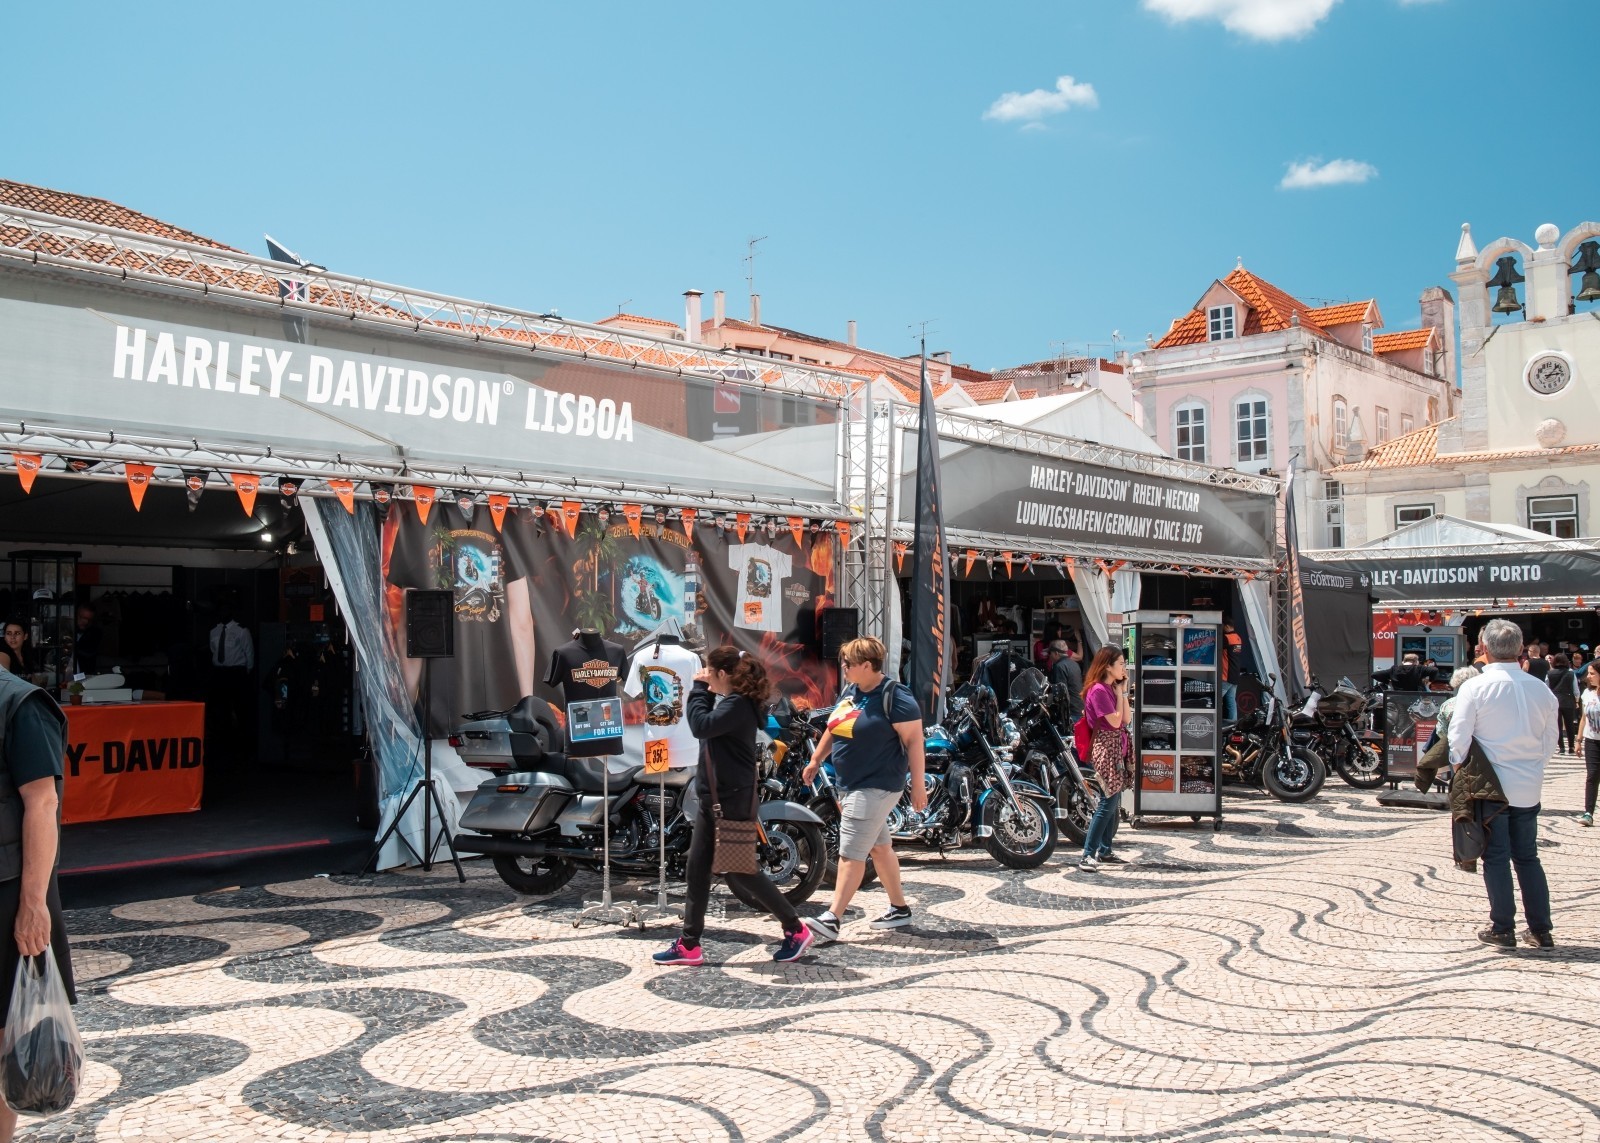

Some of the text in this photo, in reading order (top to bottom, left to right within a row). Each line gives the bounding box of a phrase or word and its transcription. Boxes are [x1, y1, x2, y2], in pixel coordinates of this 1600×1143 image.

[525, 388, 634, 442] LISBOA
[1132, 483, 1200, 513] RHEIN-NECKAR
[1016, 501, 1203, 544] LUDWIGSHAFEN/GERMANY SINCE 1976
[612, 526, 627, 538] 28TH
[629, 526, 656, 537] EOPEAN
[674, 534, 690, 549] RALLY
[1370, 565, 1541, 586] LEY-DAVIDSON® PORTO
[574, 668, 617, 679] HARLEY-DAVIDSON
[593, 726, 622, 736] FOR FREE
[652, 748, 663, 764] 35€
